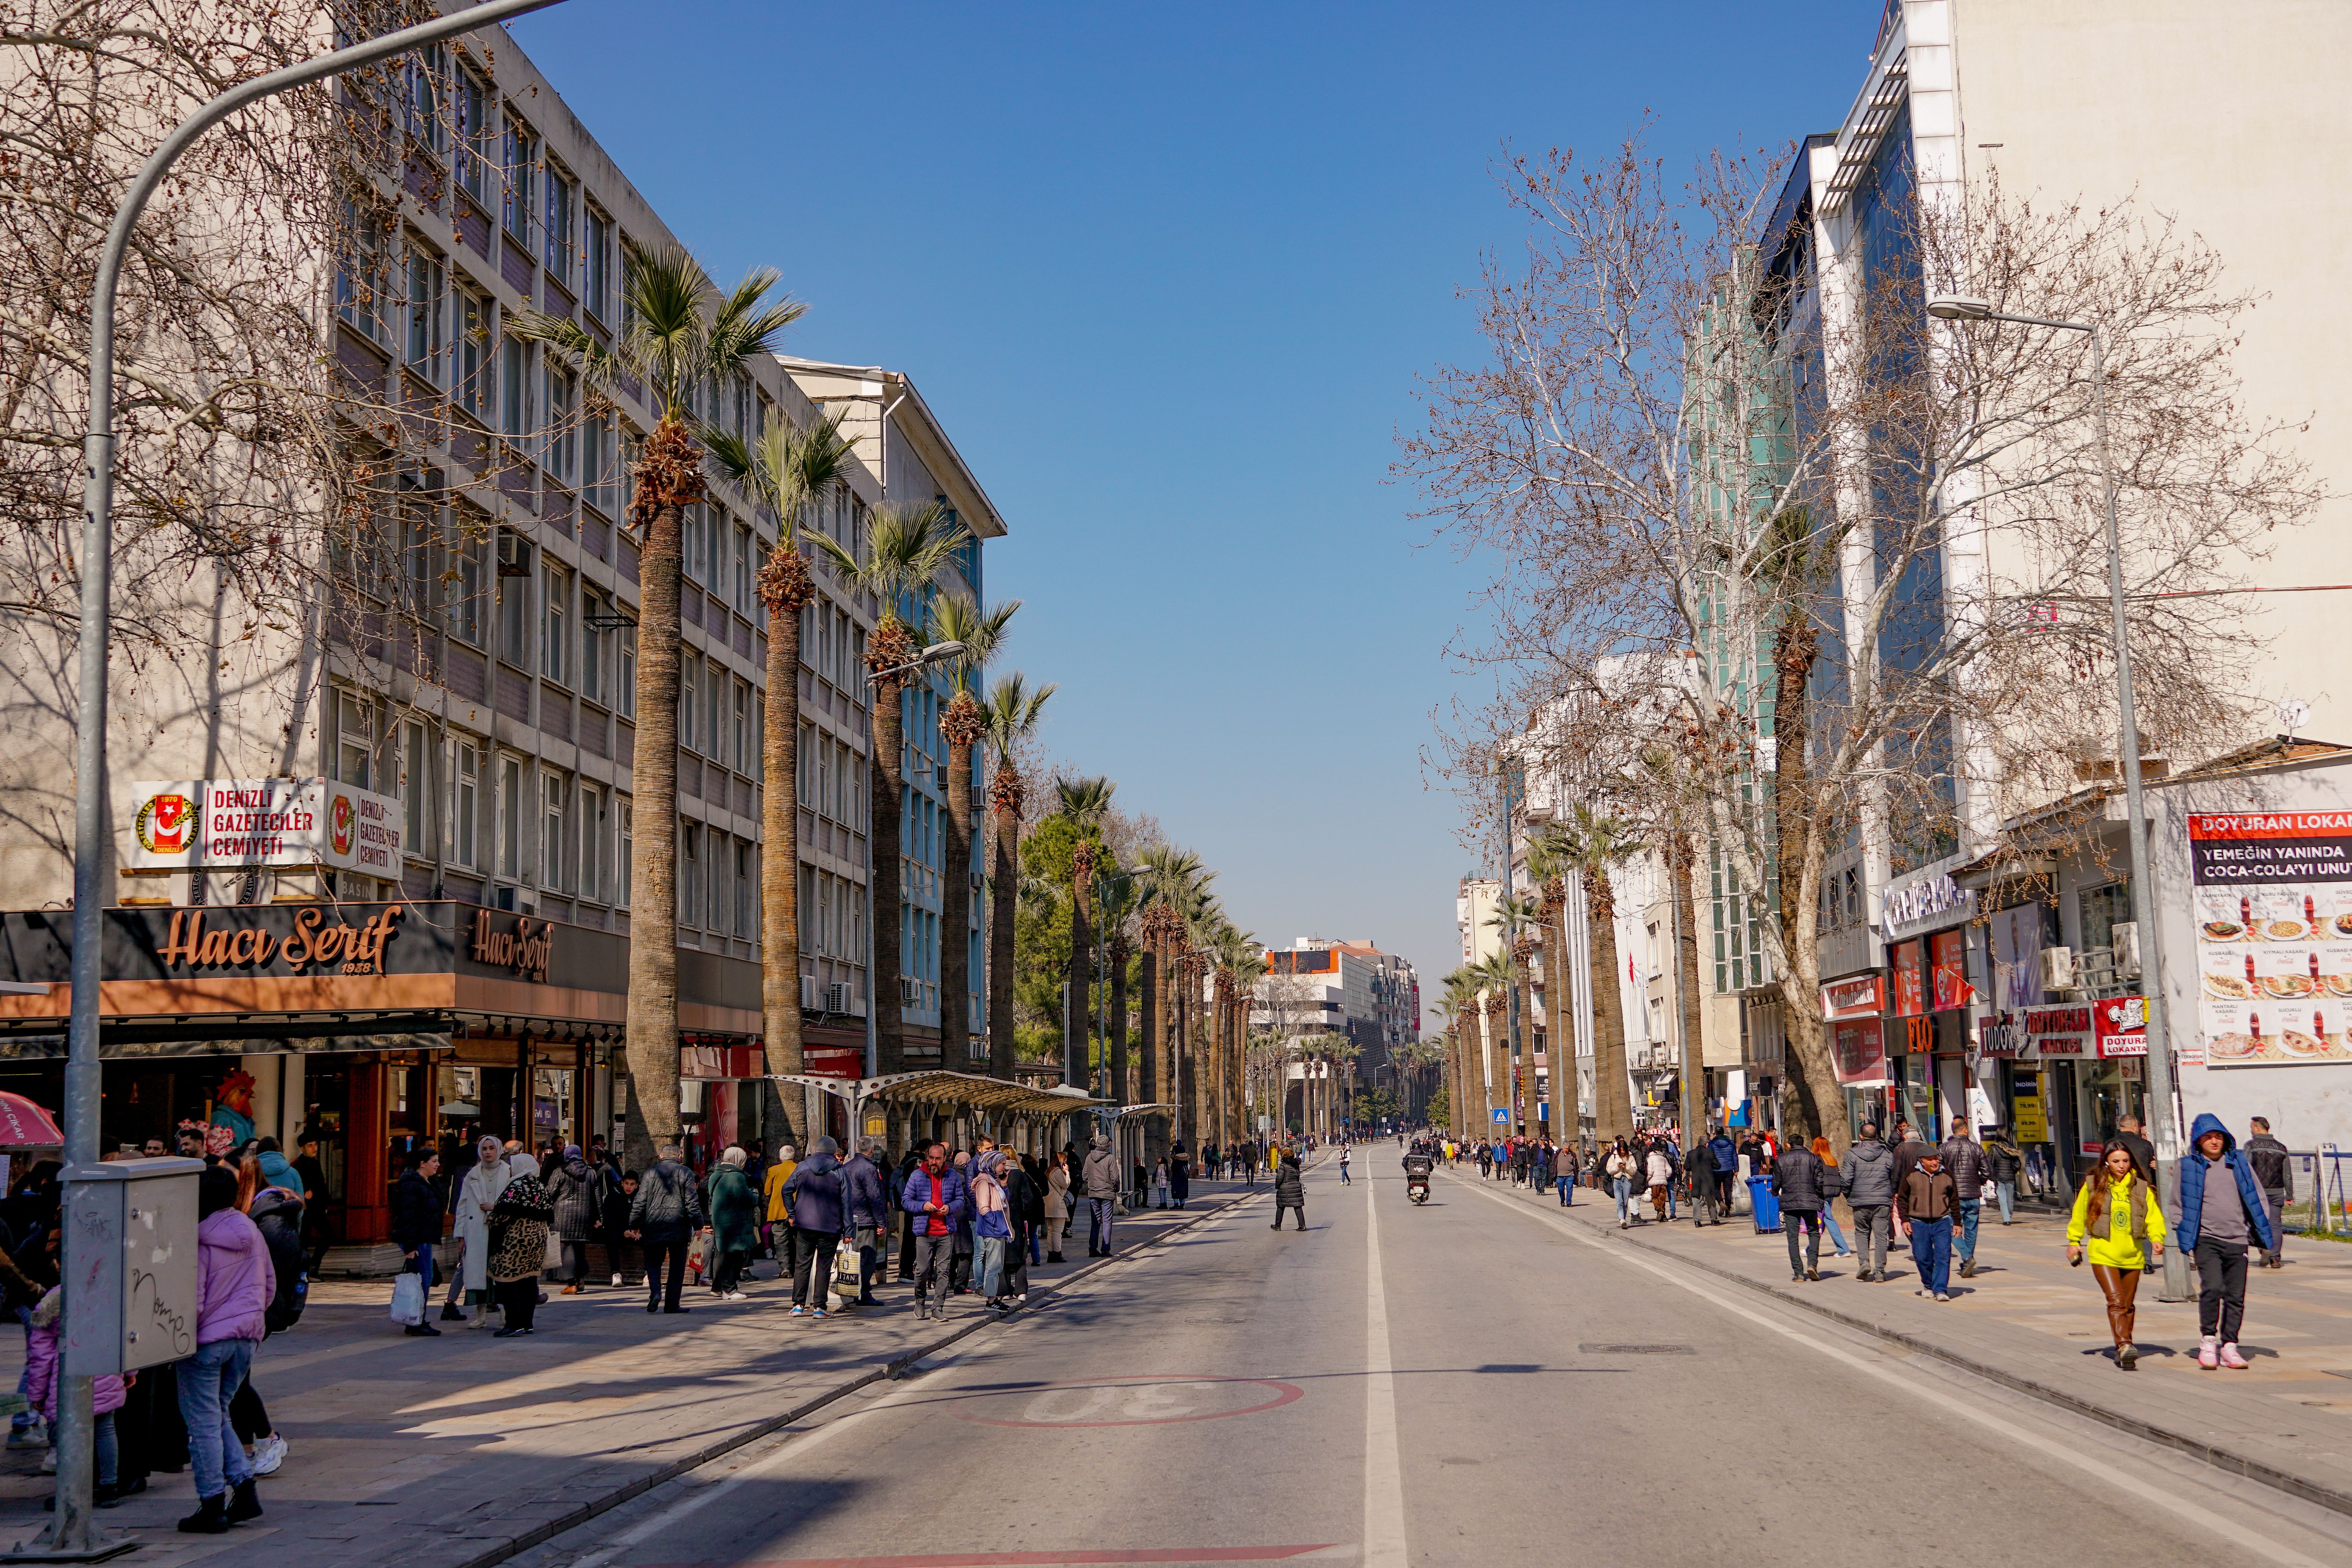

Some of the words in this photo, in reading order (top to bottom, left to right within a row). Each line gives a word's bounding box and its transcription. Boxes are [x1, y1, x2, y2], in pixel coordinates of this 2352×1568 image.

[215, 789, 272, 808] DENİZLİ
[214, 813, 312, 831] GAZETECİLER
[2202, 816, 2291, 831] DOYURAN
[361, 822, 399, 848] GAZETECİLER
[214, 837, 282, 855] CEMİYETİ
[361, 845, 388, 867] CEMİYETİ
[2202, 846, 2272, 860] YEMEĞİN
[2275, 846, 2345, 859] YANINDA
[343, 882, 370, 898] BASIN
[157, 910, 276, 965] Hacı
[282, 905, 403, 973] Şerif
[472, 909, 516, 966] Hacı
[517, 917, 554, 983] Şerif
[341, 963, 371, 973] 1938
[2028, 1007, 2088, 1033] DOYURAN
[1907, 1015, 1932, 1052] FLO
[1024, 1381, 1217, 1421] 30
